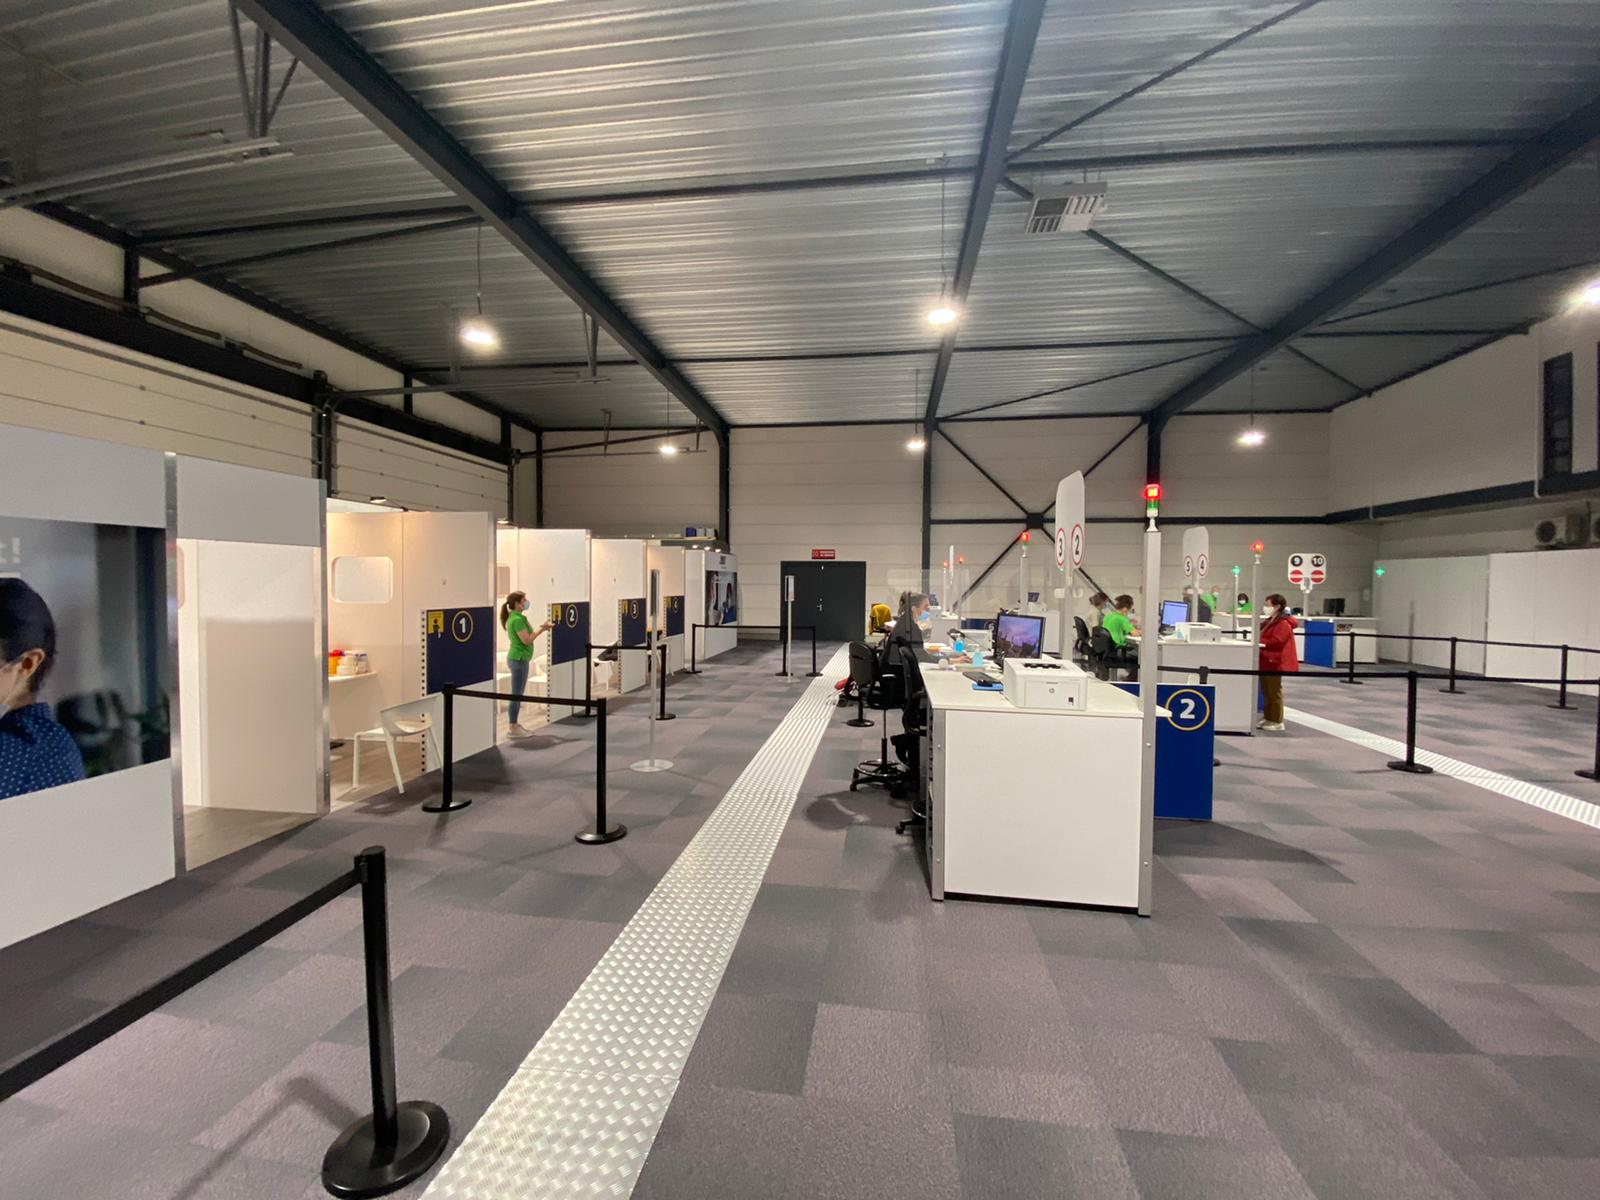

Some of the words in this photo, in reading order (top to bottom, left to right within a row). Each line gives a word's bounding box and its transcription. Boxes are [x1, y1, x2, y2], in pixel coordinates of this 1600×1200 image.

[1058, 537, 1063, 557] 3
[1074, 534, 1080, 555] 2
[1294, 557, 1301, 565] 9
[1313, 557, 1323, 565] 10
[569, 609, 576, 622] 2
[633, 603, 637, 614] 3
[459, 617, 466, 634] 1
[1180, 698, 1196, 720] 2
